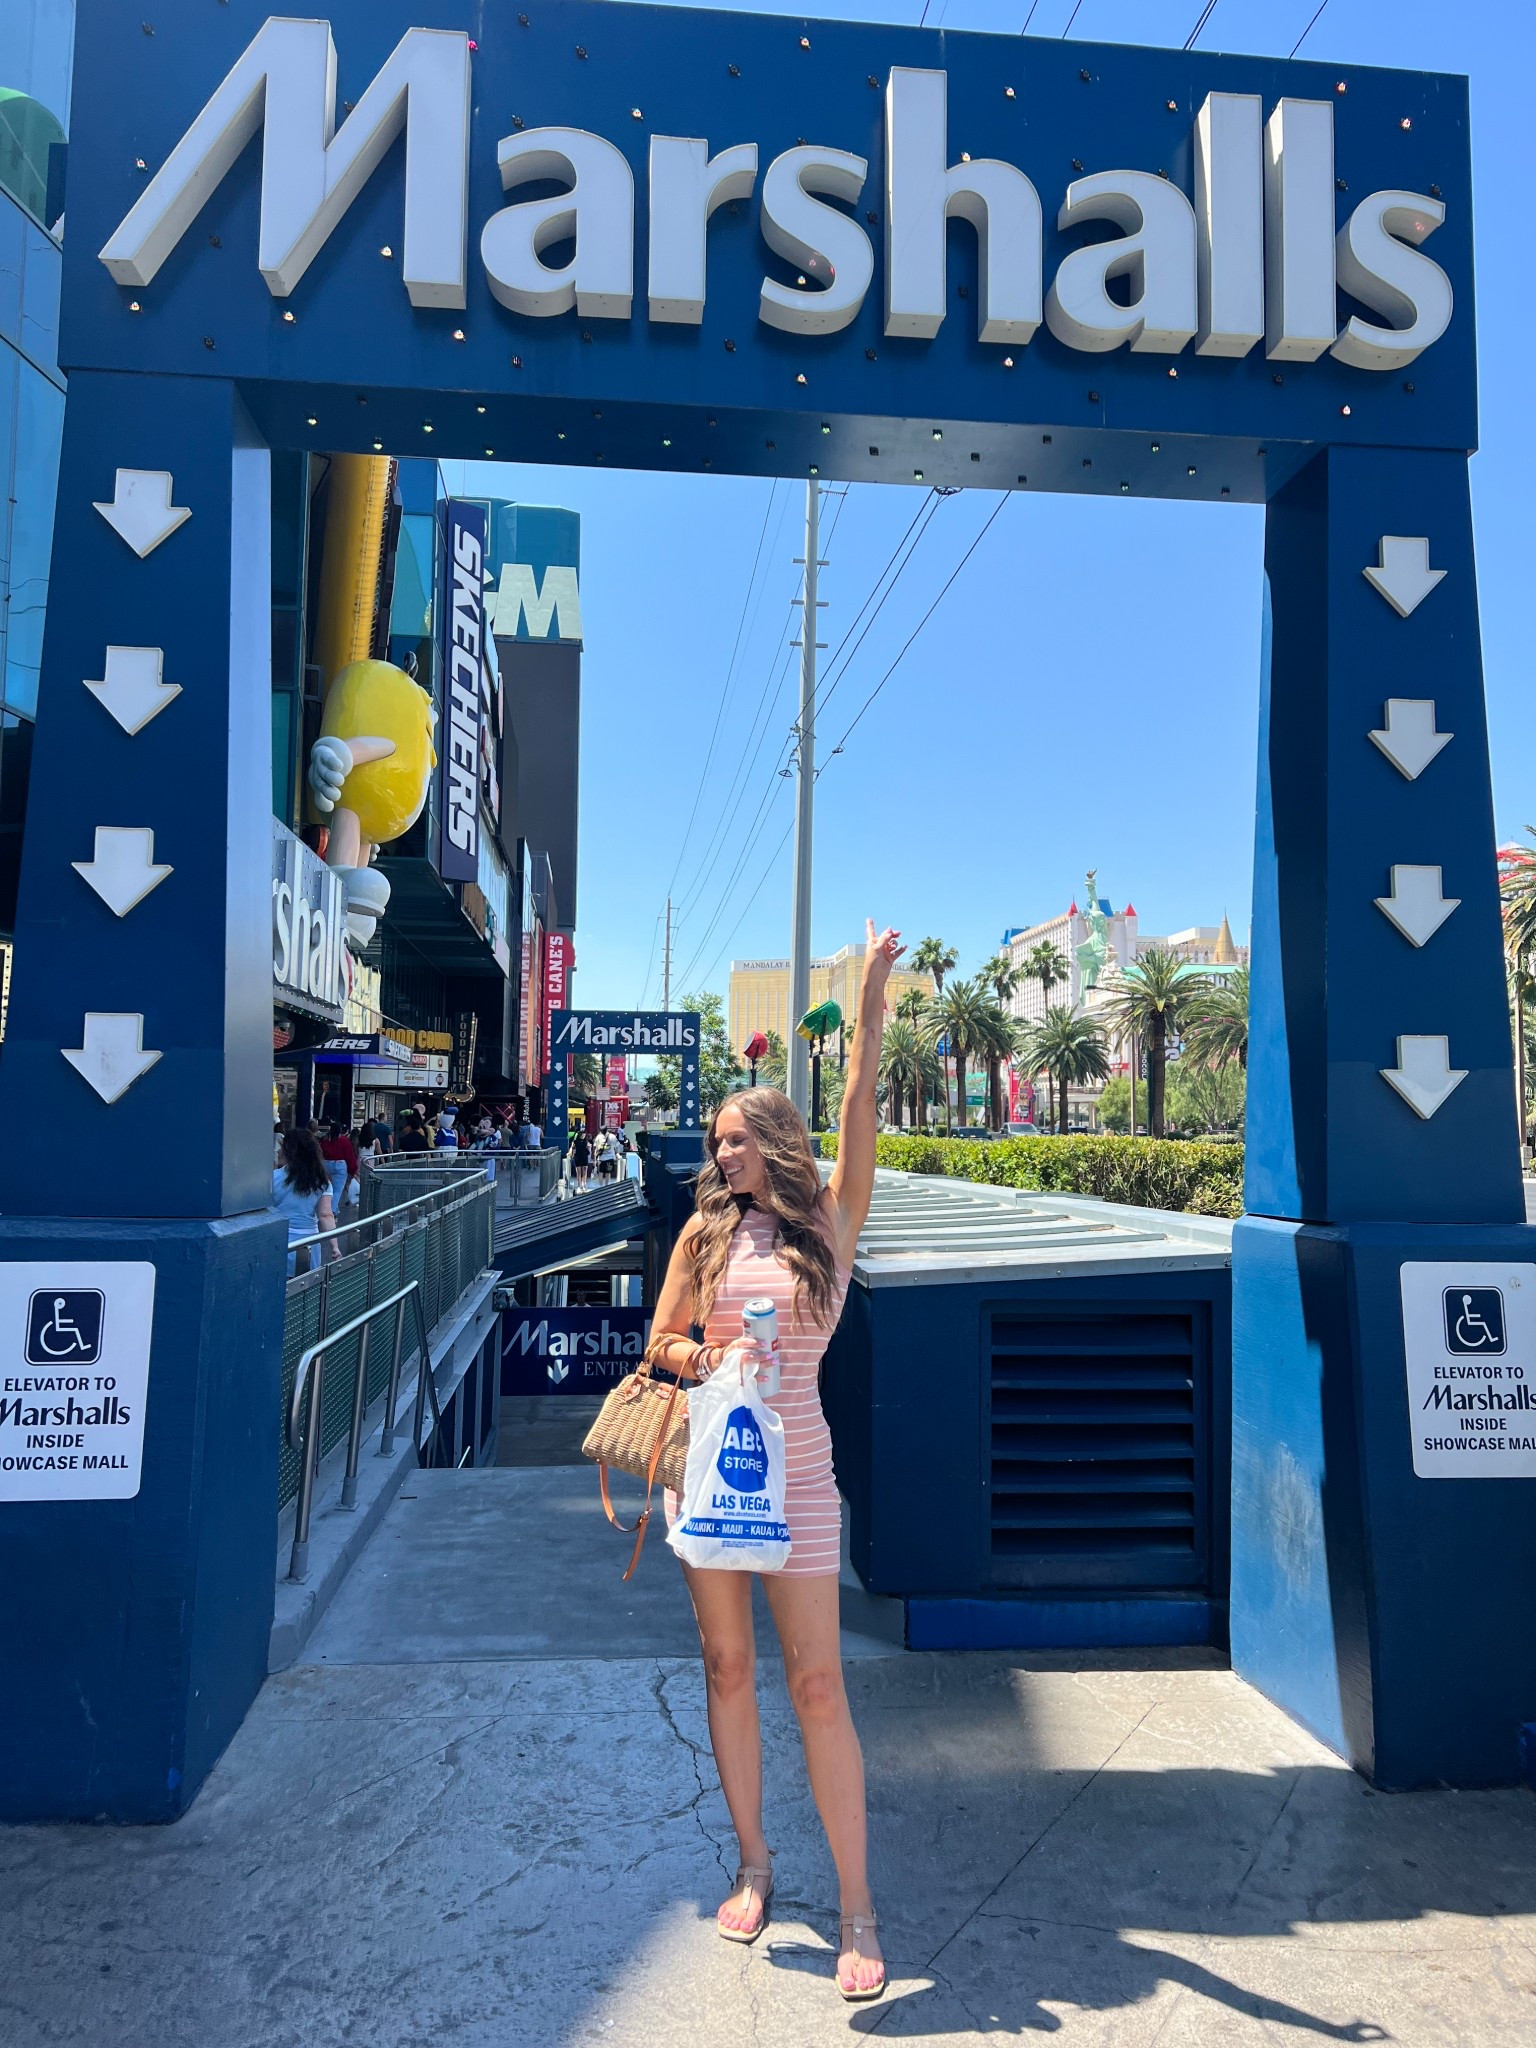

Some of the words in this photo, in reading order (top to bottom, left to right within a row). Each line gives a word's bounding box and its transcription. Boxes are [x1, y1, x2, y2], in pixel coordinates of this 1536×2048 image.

[97, 16, 1454, 371] Marshalls
[483, 563, 582, 640] M
[449, 522, 482, 856] SKECHERS
[272, 839, 350, 1009] shalls
[549, 935, 564, 993] CANE'S
[460, 1013, 468, 1047] FOOD
[555, 1016, 696, 1047] Marshalls
[458, 1049, 467, 1091] COURT
[1434, 1366, 1503, 1379] ELEVATOR
[1506, 1366, 1524, 1379] TO
[4, 1377, 89, 1392] ELEVATOR
[94, 1376, 116, 1391] TO
[1422, 1384, 1536, 1411] Marshalls
[1460, 1418, 1507, 1431] INSIDE
[26, 1434, 85, 1449] INSIDE
[1424, 1437, 1505, 1451] SHOWCASE
[0, 1456, 78, 1471] OWCASE
[82, 1455, 129, 1470] MALL
[724, 1456, 763, 1473] STORE
[712, 1493, 736, 1509] LAS
[722, 1524, 744, 1535] MAUI
